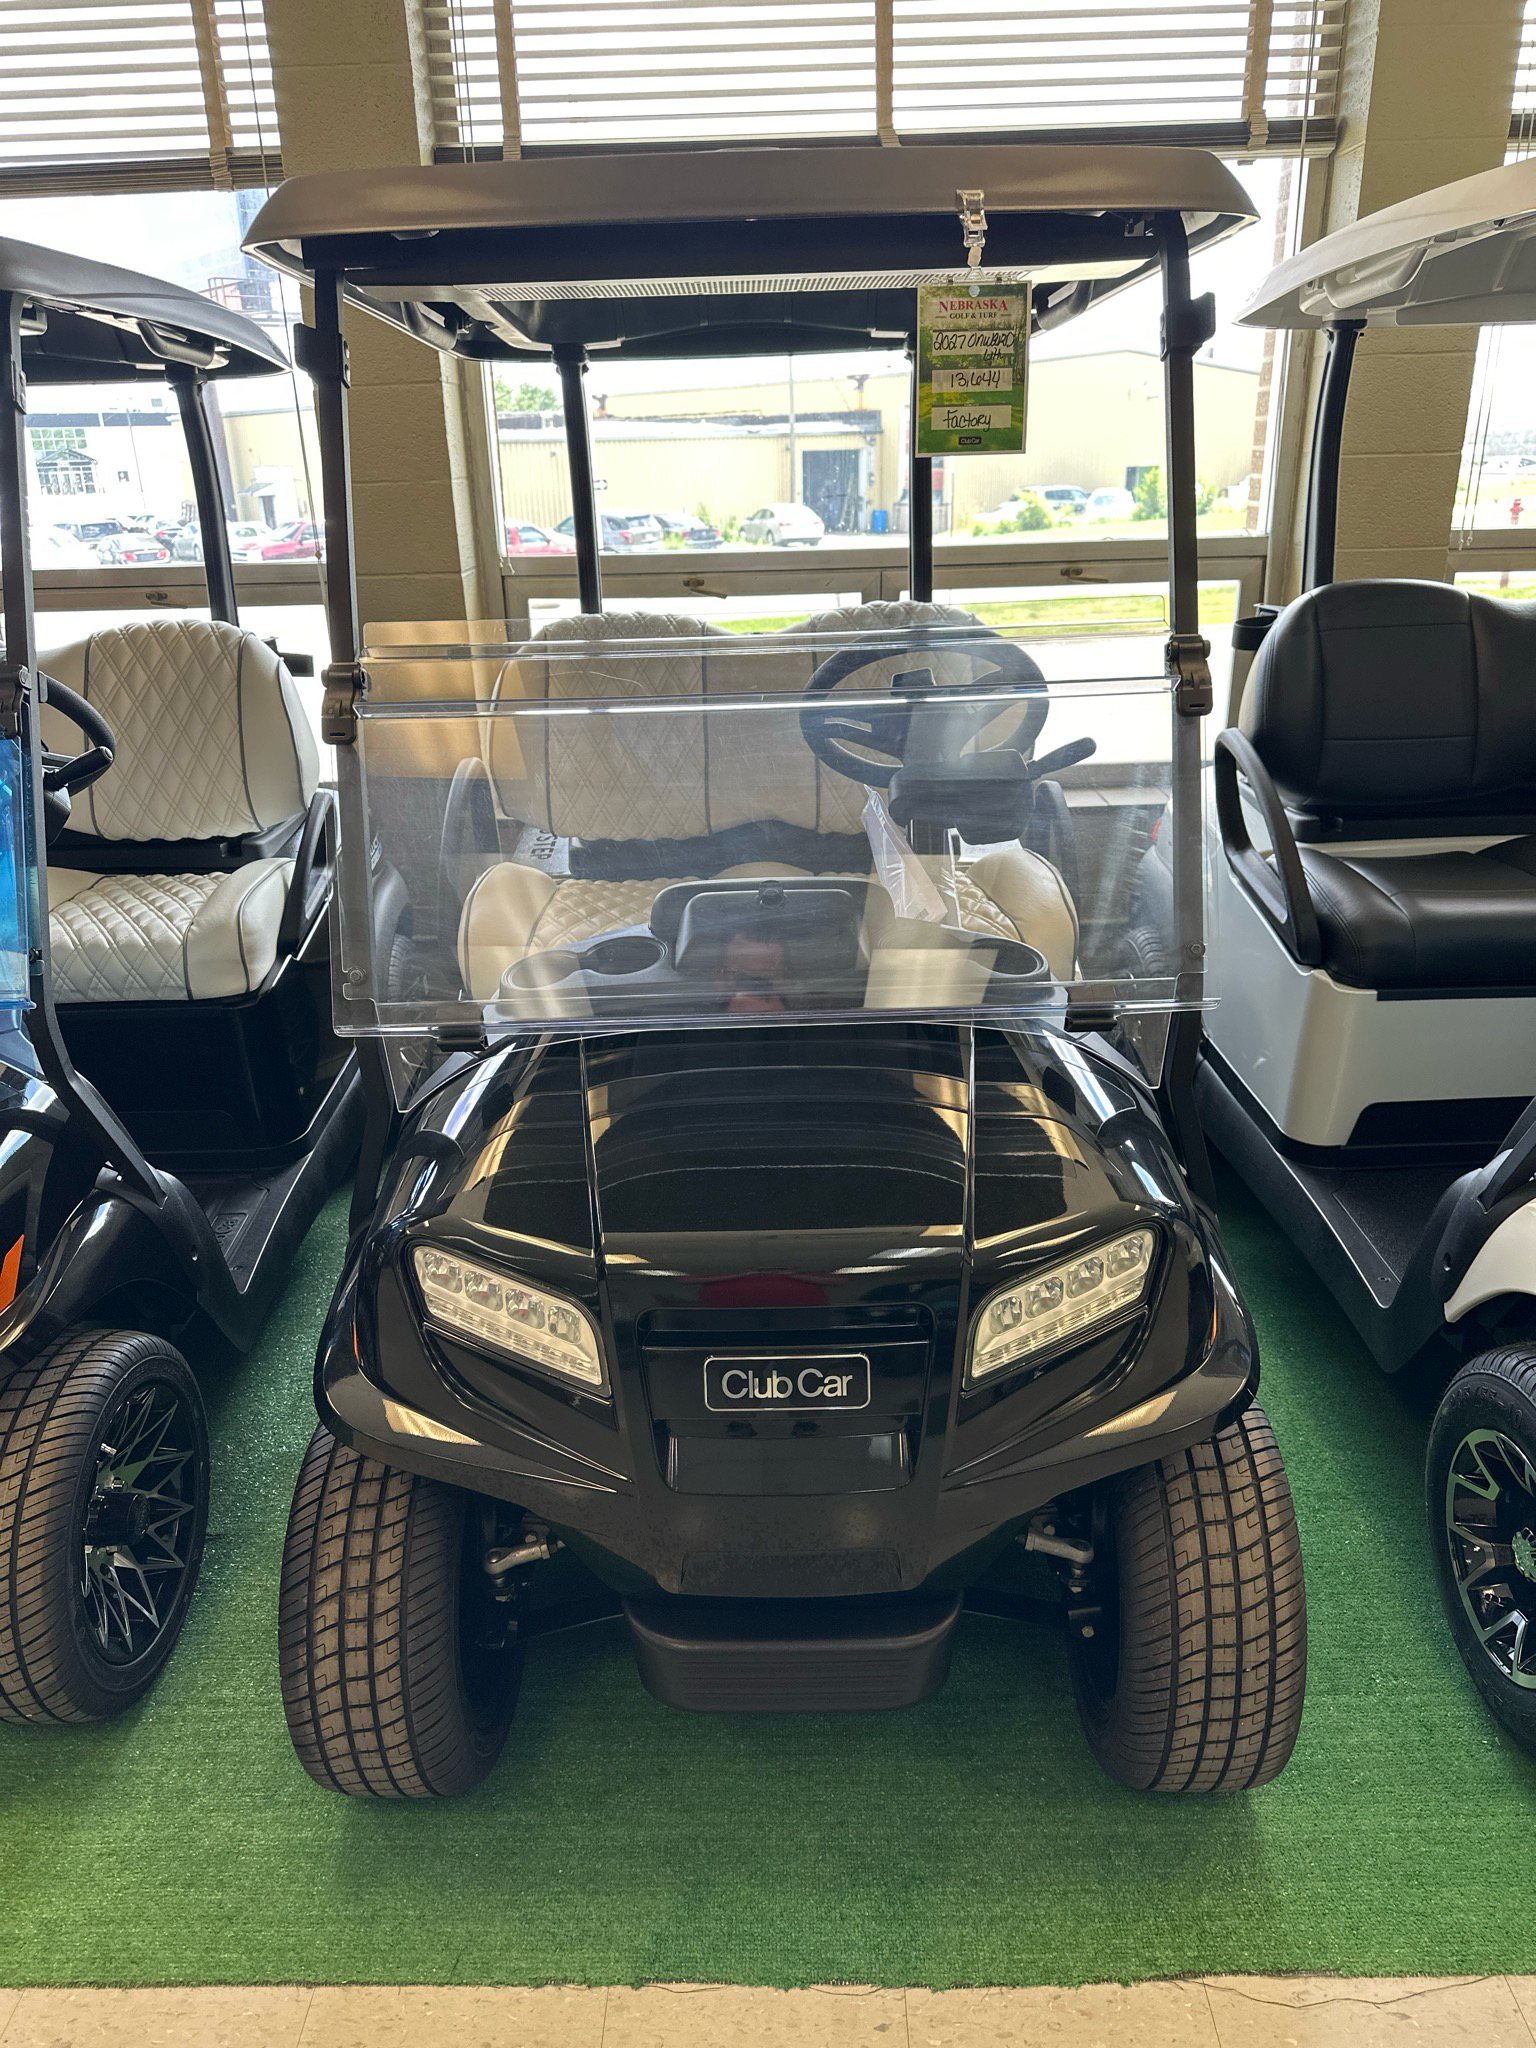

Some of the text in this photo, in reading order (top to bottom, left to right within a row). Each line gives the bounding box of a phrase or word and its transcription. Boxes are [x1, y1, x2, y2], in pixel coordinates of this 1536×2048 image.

[939, 299, 1008, 313] NEBRASKA
[949, 312, 970, 320] GOLF
[978, 311, 998, 319] TURF
[933, 331, 967, 351] 2027
[951, 369, 1001, 389] 13,644
[530, 835, 557, 860] STEP
[721, 1368, 853, 1399] Club Car
